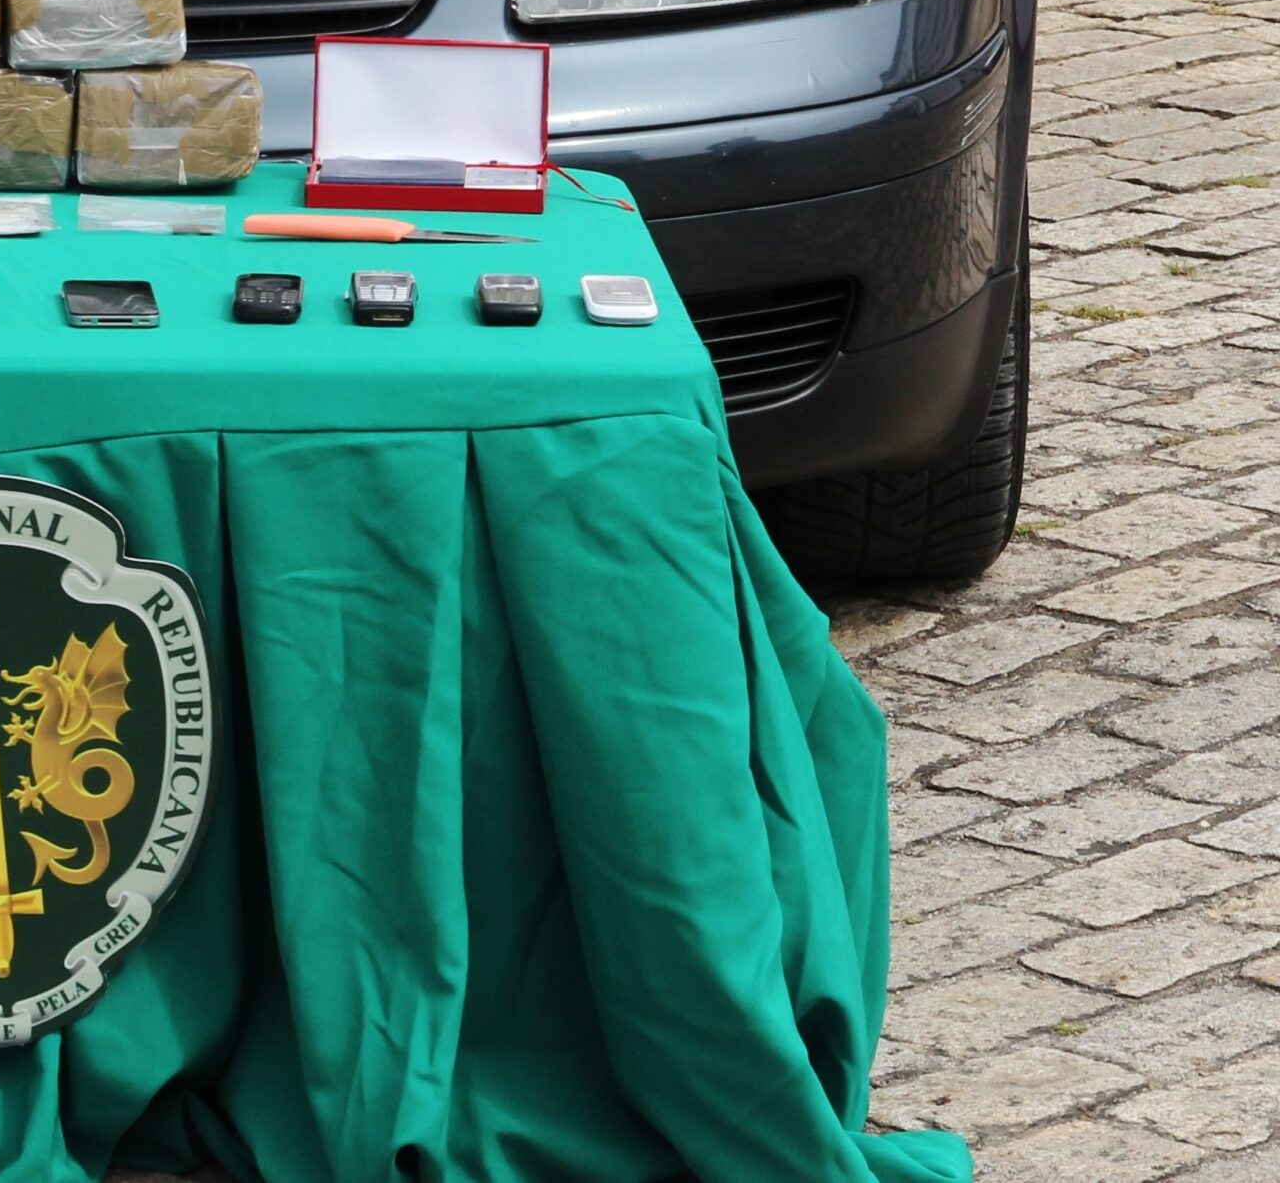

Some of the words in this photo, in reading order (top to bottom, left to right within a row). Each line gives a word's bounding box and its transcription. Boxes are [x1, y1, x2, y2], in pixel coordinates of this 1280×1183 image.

[136, 587, 204, 876] REPUBLICANA
[3, 1023, 17, 1041] E
[36, 980, 90, 1018] PELA
[93, 913, 141, 955] GREI
